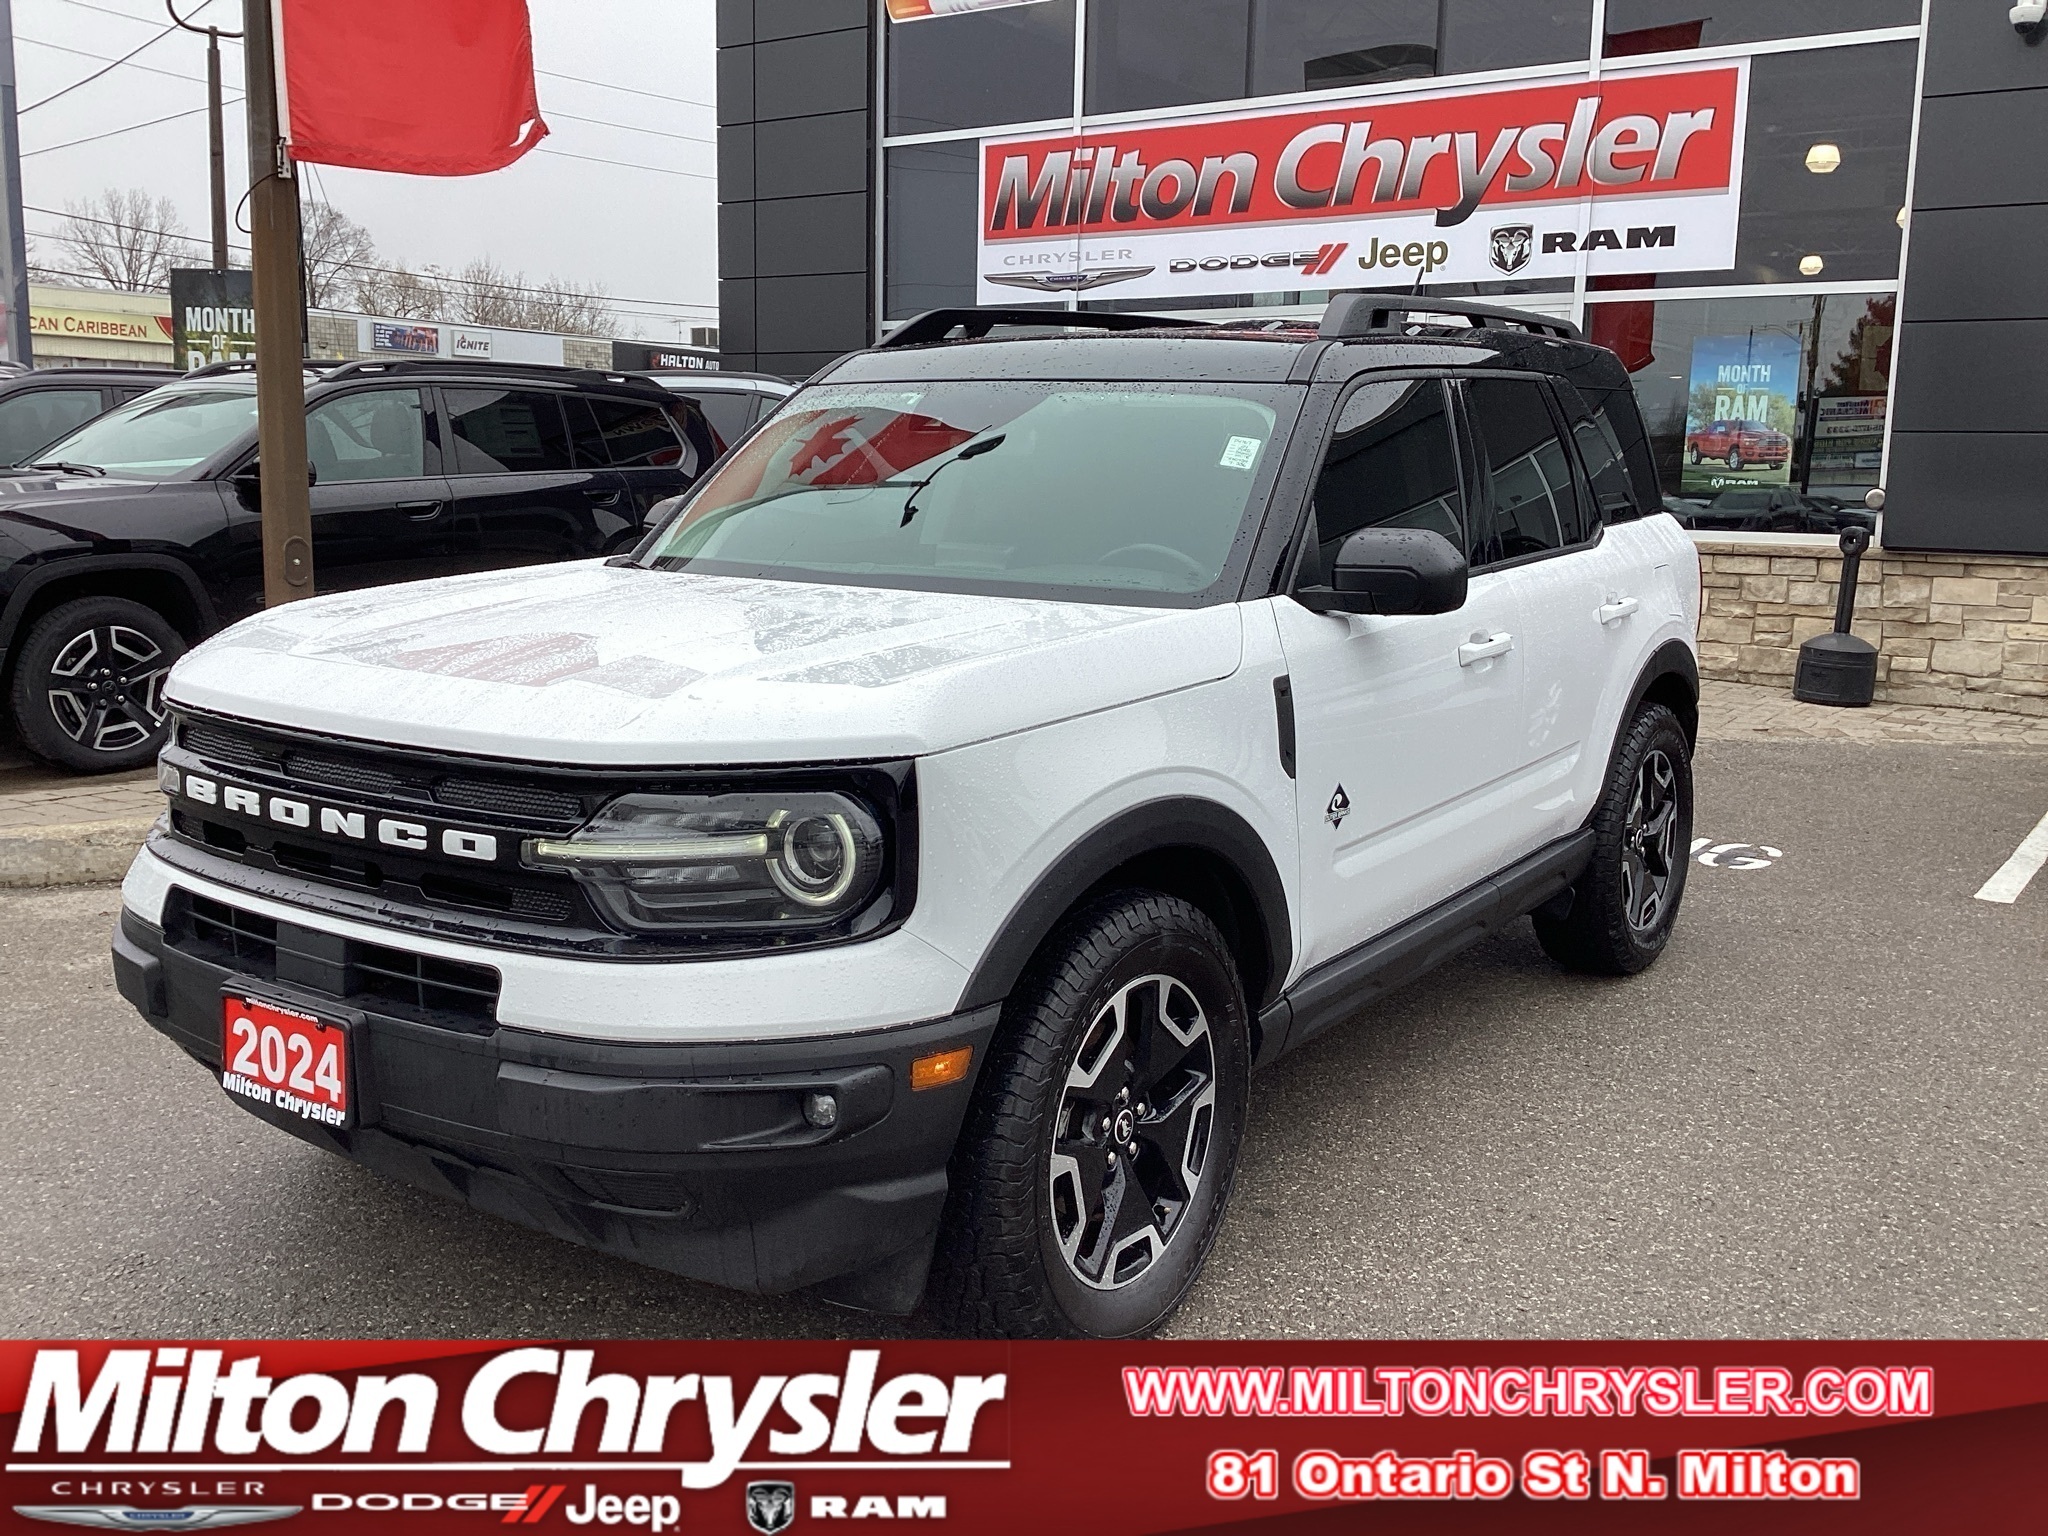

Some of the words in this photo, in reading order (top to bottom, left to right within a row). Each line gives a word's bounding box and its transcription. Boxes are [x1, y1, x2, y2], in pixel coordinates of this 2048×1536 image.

[989, 145, 1259, 231] Milton
[1274, 96, 1716, 228] Chrysler
[1541, 225, 1676, 254] RAM
[1003, 248, 1133, 266] CHRYSLER
[1169, 250, 1320, 273] DODGE
[1358, 237, 1449, 273] Jeep
[63, 316, 148, 338] CARIBBEAN
[185, 306, 256, 334] MONTH
[211, 334, 227, 350] OF
[456, 339, 489, 351] IGNITE
[660, 353, 704, 369] HALTON
[705, 360, 720, 371] AUTO
[1717, 364, 1772, 383] MONTH
[1736, 383, 1749, 394] OF
[1714, 395, 1769, 422] RAM
[185, 774, 498, 861] BRONCO
[232, 1017, 342, 1104] 2024
[222, 1071, 273, 1104] Milton
[275, 1089, 346, 1127] Chrysler
